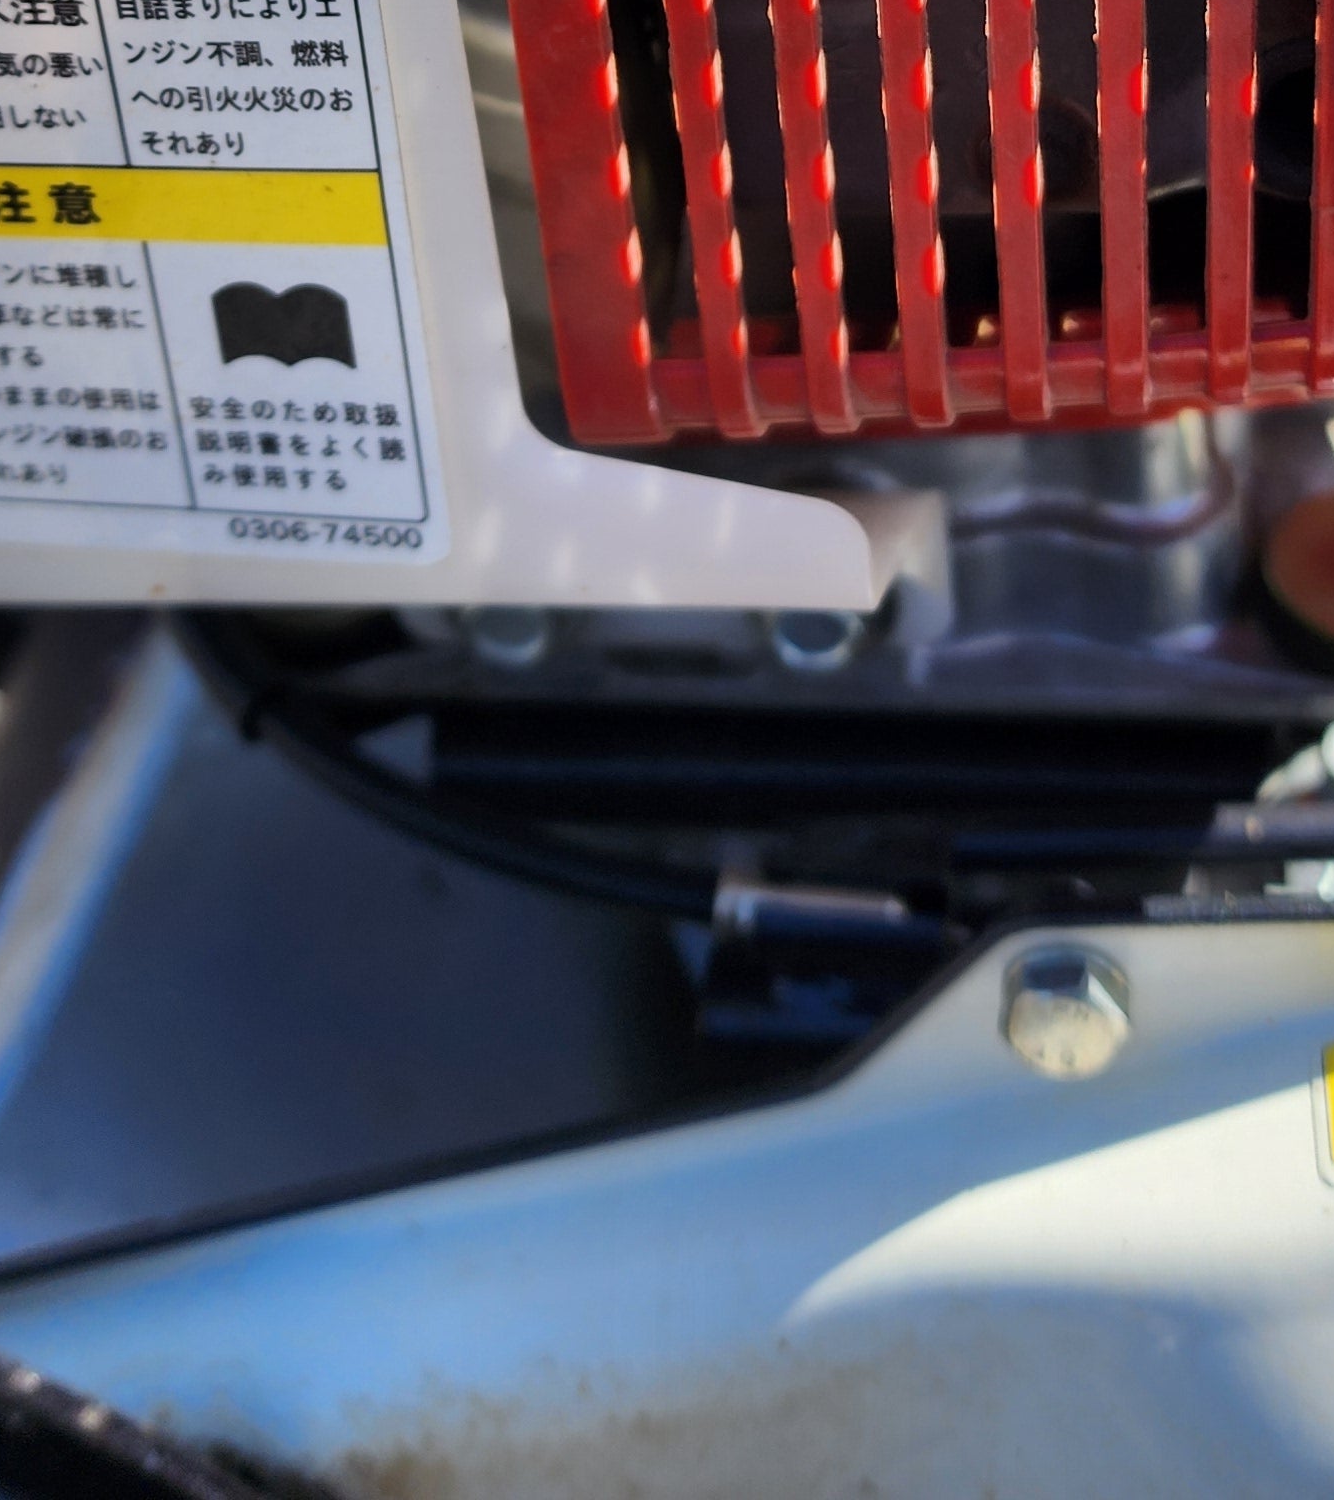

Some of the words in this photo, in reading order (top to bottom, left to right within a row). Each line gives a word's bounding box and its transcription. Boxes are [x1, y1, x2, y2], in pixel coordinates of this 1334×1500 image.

[123, 40, 349, 67] ンジン不調、燃料
[132, 86, 354, 112] への引火火災のお
[141, 131, 245, 156] それあり
[190, 396, 402, 427] 安全のため取扱
[203, 463, 347, 491] み使用する
[229, 517, 424, 549] 0306-74500
